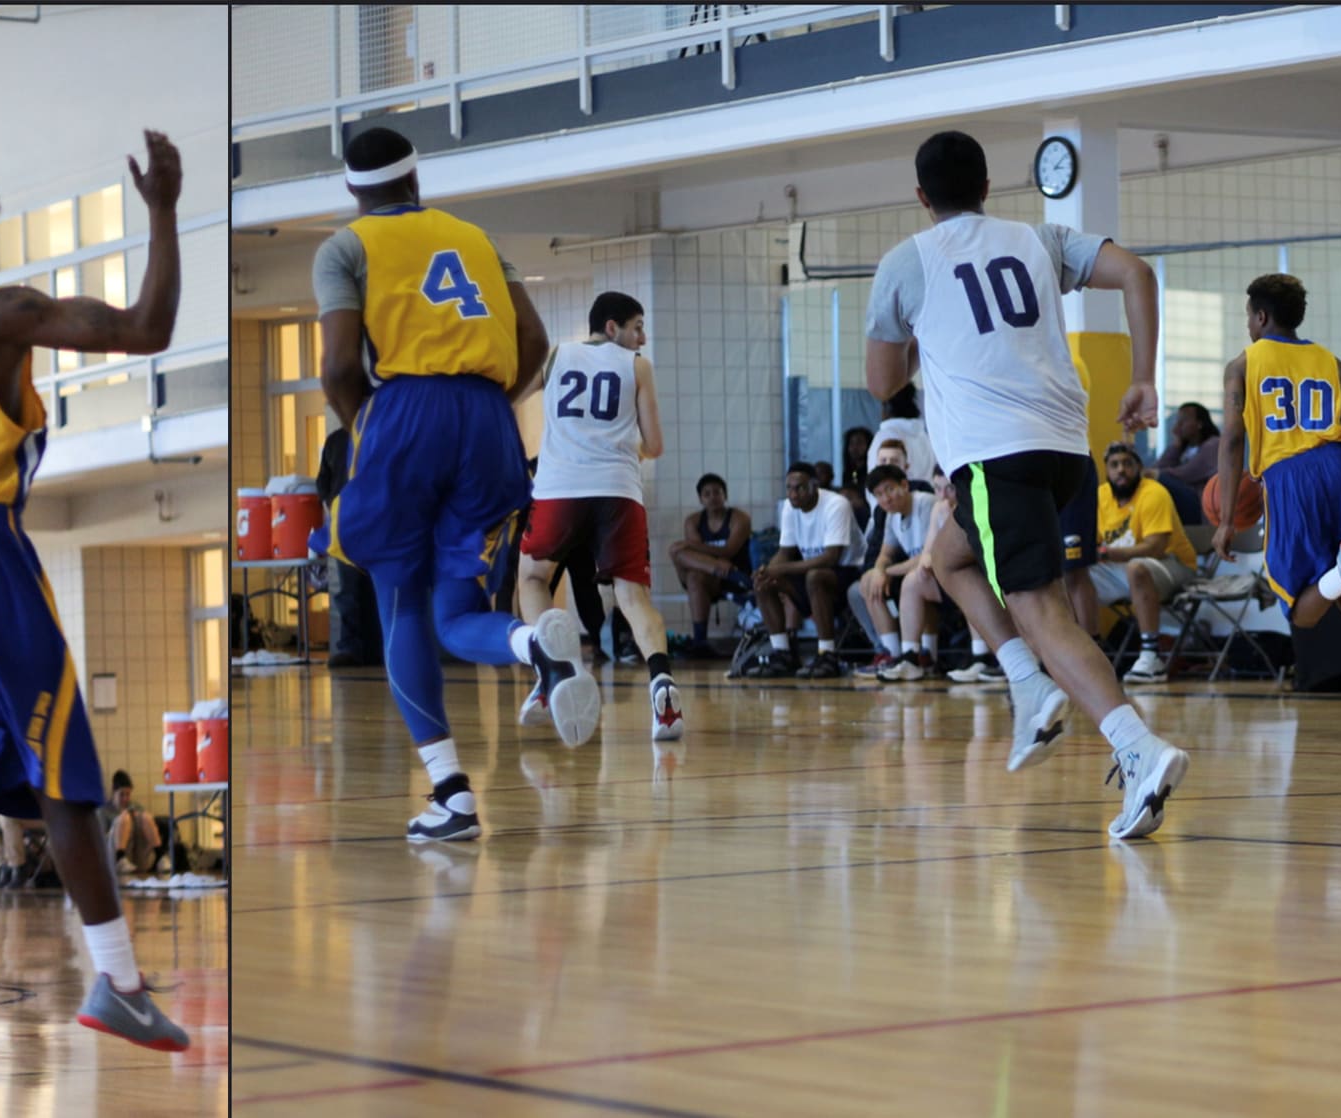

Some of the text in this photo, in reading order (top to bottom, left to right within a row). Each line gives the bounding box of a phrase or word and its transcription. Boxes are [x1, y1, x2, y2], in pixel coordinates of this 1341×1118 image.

[420, 249, 490, 320] 4
[954, 256, 1040, 334] 10
[558, 371, 621, 421] 20
[1260, 376, 1334, 433] 30
